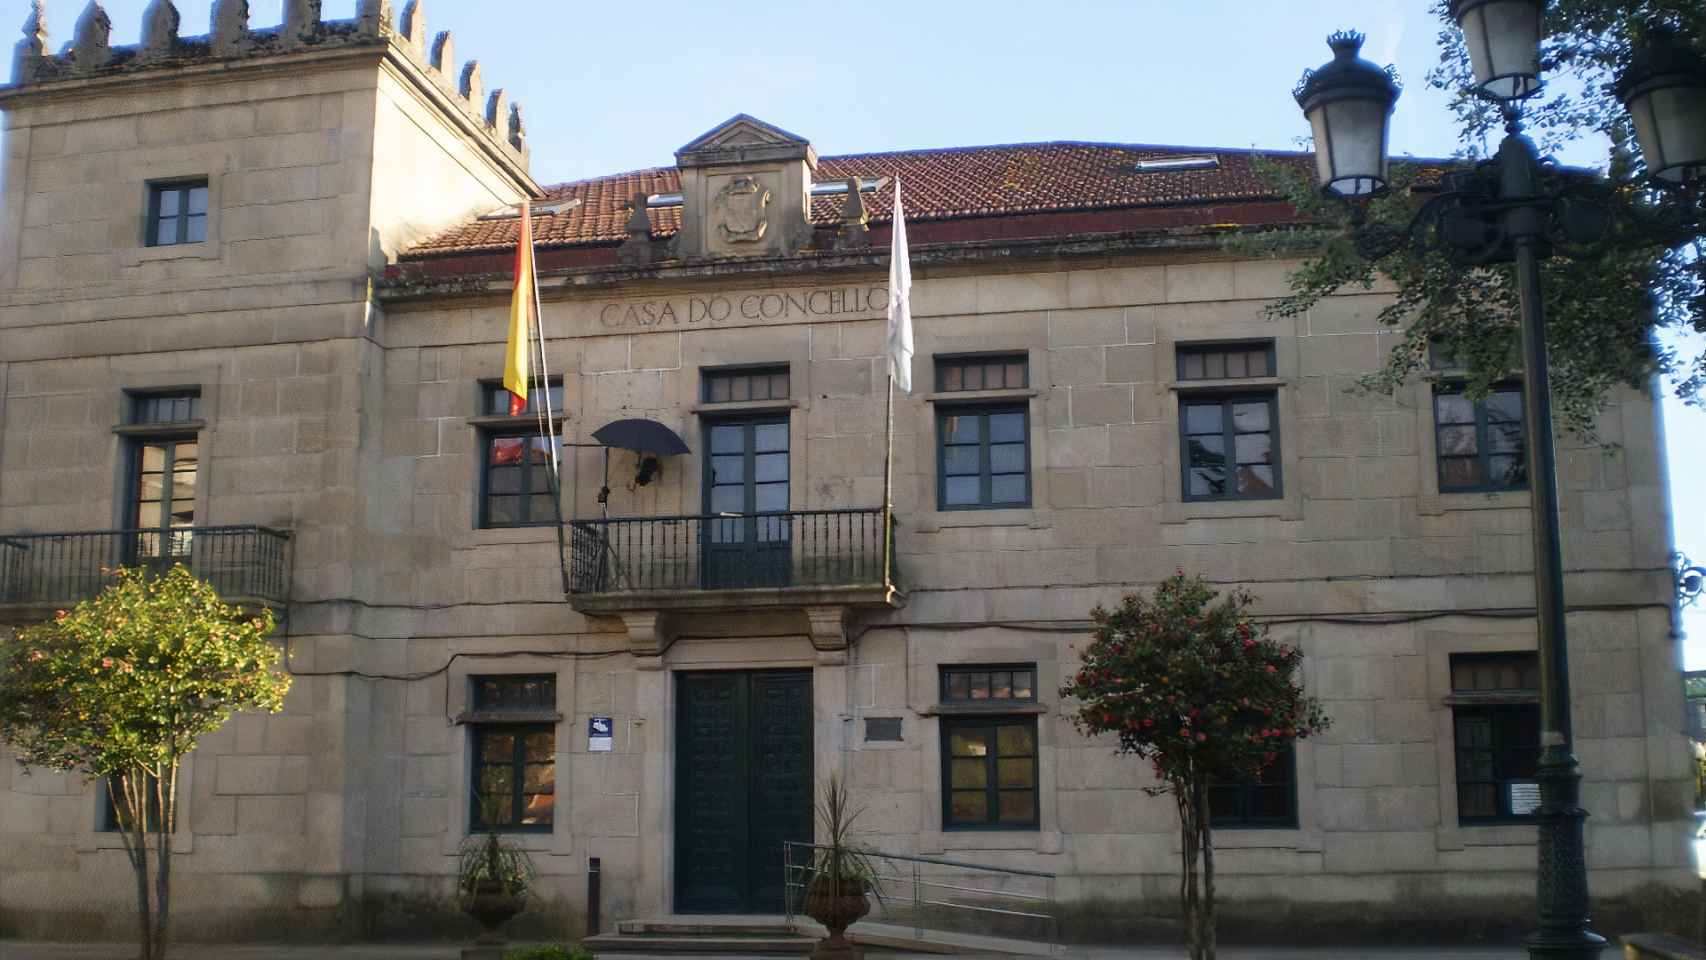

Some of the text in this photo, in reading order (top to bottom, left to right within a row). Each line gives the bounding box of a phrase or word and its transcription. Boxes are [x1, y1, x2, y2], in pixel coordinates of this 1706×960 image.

[600, 286, 890, 328] CASA DO CONCELLO
